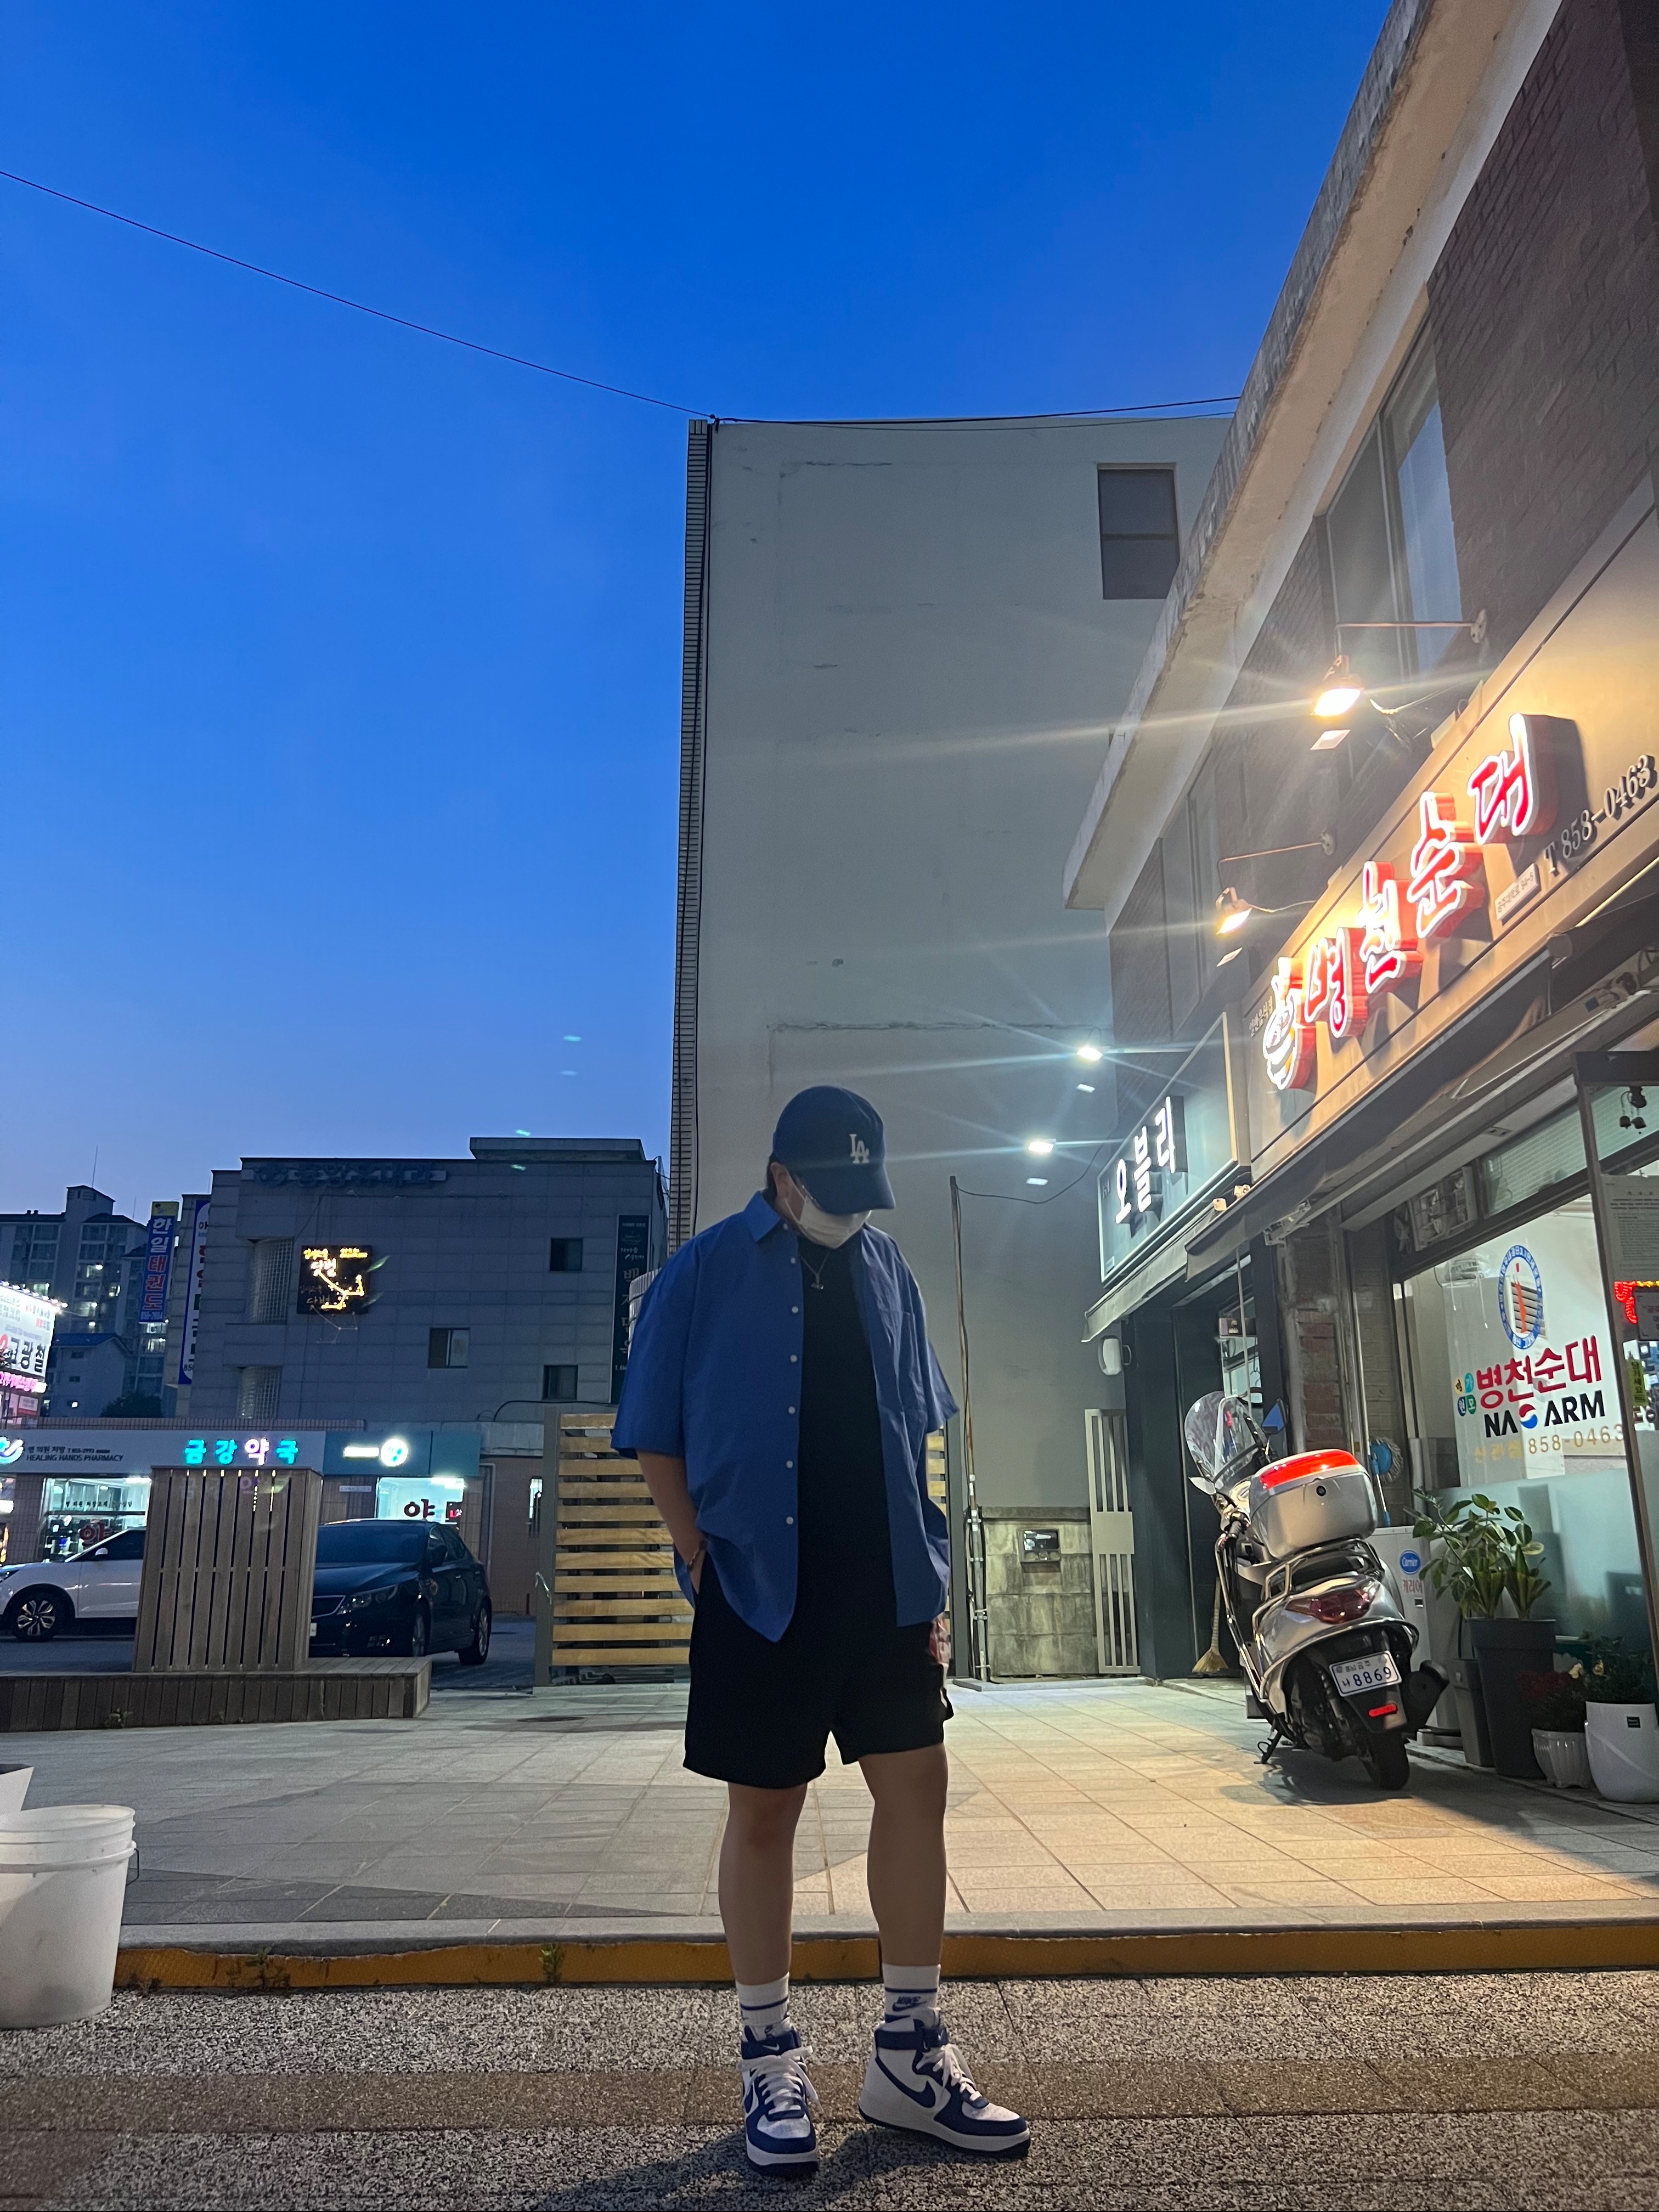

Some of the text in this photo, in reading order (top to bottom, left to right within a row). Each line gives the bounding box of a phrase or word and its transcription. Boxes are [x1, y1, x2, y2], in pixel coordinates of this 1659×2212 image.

[1543, 754, 1651, 874] T 858-0463
[1305, 713, 1533, 1038] 병천순대
[849, 1133, 870, 1164] LA
[1116, 1096, 1175, 1224] 오블리
[1476, 1334, 1602, 1409] 병천순대
[184, 1437, 299, 1465] 금강약국
[1528, 1423, 1623, 1454] 858-0463
[1402, 1556, 1418, 1567] Carrier
